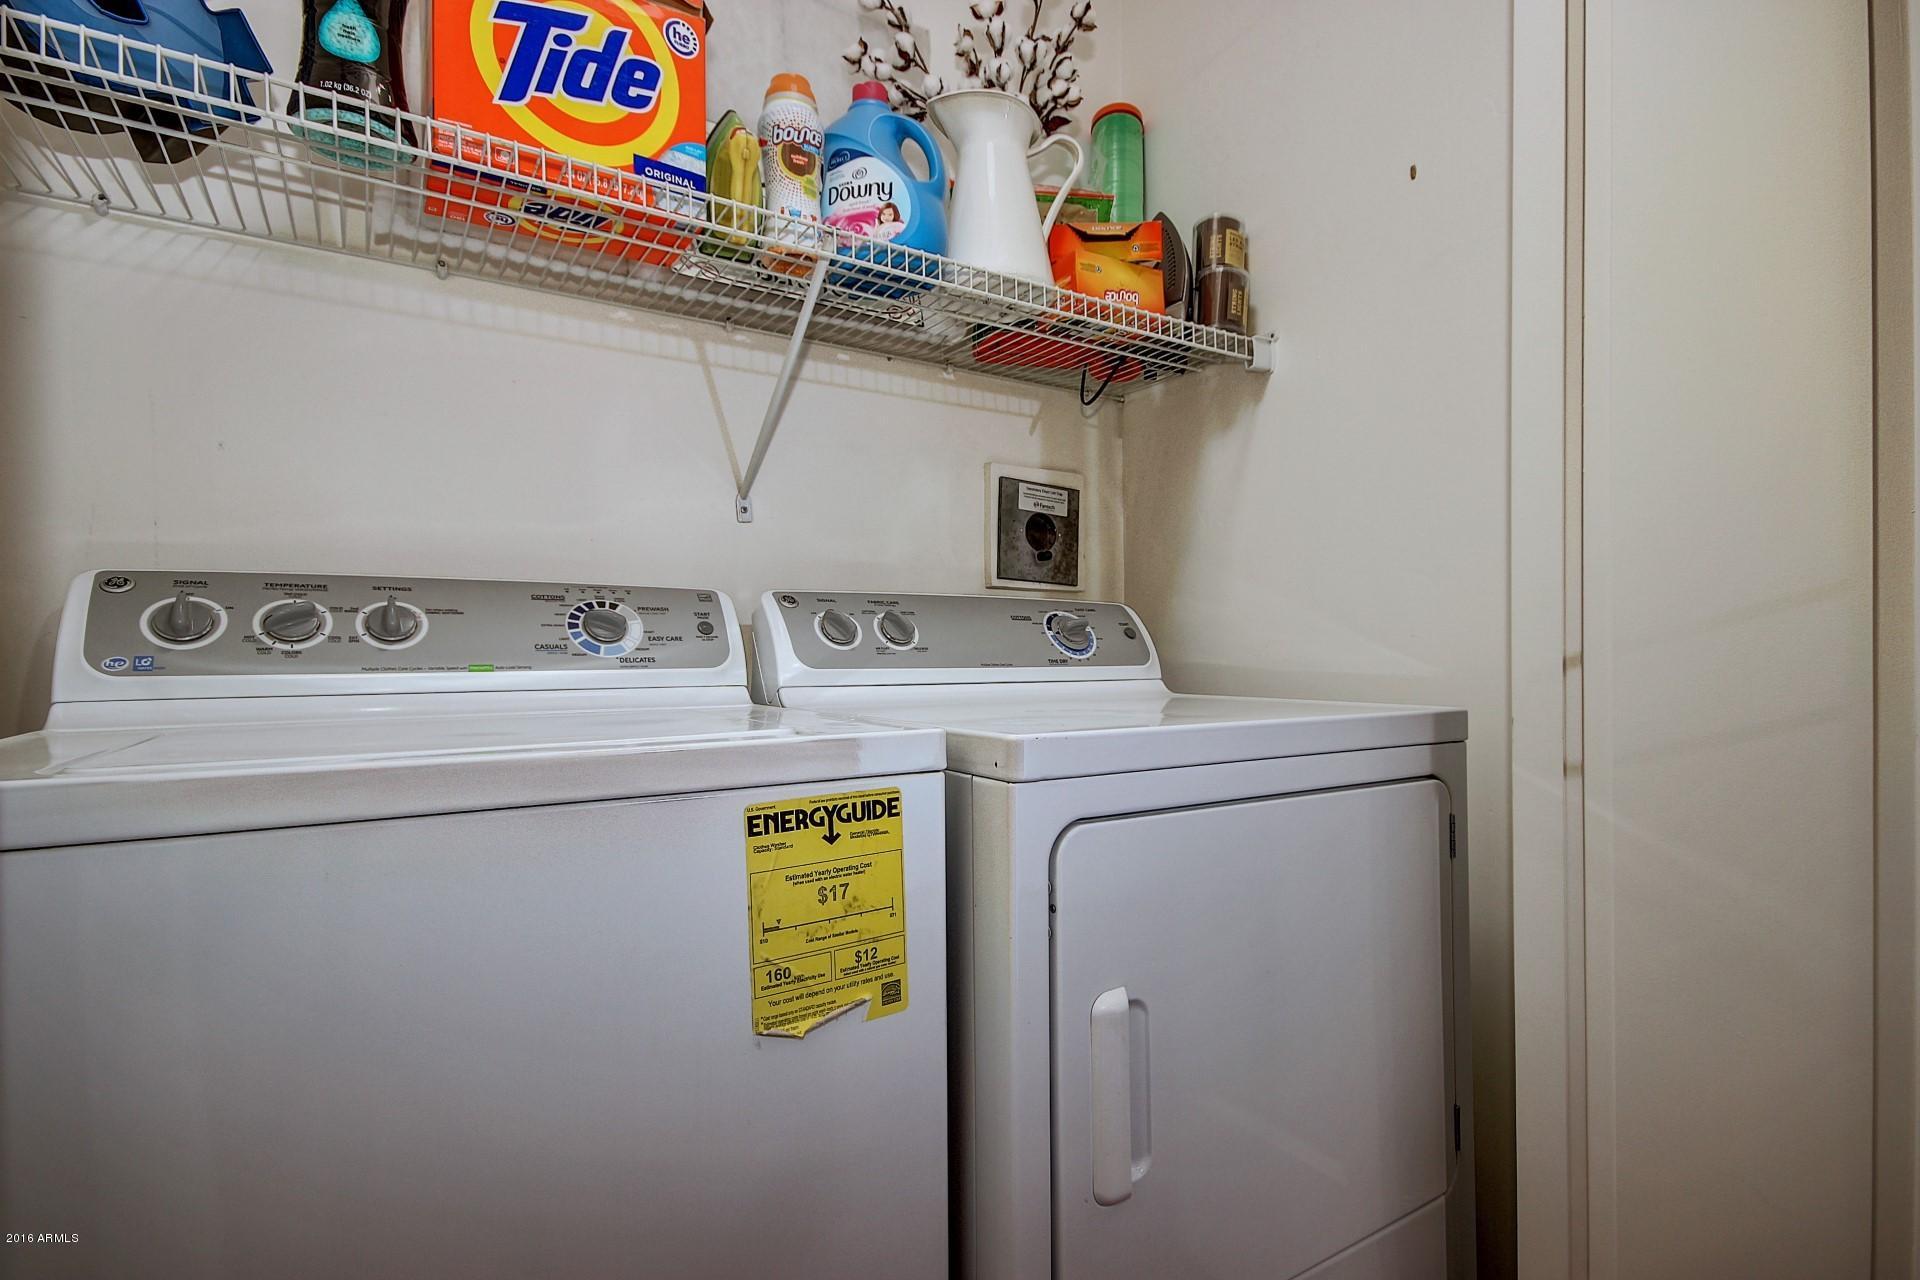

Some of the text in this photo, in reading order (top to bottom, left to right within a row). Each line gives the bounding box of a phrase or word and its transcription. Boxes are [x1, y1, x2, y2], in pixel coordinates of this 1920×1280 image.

[673, 26, 690, 45] he
[491, 0, 662, 111] Tide
[320, 80, 332, 88] 1.02
[333, 82, 342, 91] kg
[343, 82, 359, 94] (36.2
[772, 124, 822, 147] bounce
[645, 167, 696, 189] ORIGINAL
[828, 181, 893, 206] Downy
[1104, 289, 1139, 306] bounce
[746, 797, 900, 838] ENERGYGUIDE
[785, 872, 813, 881] Estimated
[814, 868, 832, 877] Yearly
[832, 864, 859, 873] Operating
[818, 882, 850, 906] $17
[855, 947, 878, 965] $12
[765, 967, 792, 983] 160
[761, 981, 782, 991] Estimated
[768, 1000, 781, 1008] Your
[783, 997, 794, 1005] cost
[795, 993, 804, 1001] will
[805, 988, 825, 999] depend
[834, 984, 846, 993] your
[846, 980, 859, 989] utility
[861, 977, 873, 985] rates
[874, 973, 884, 981] and
